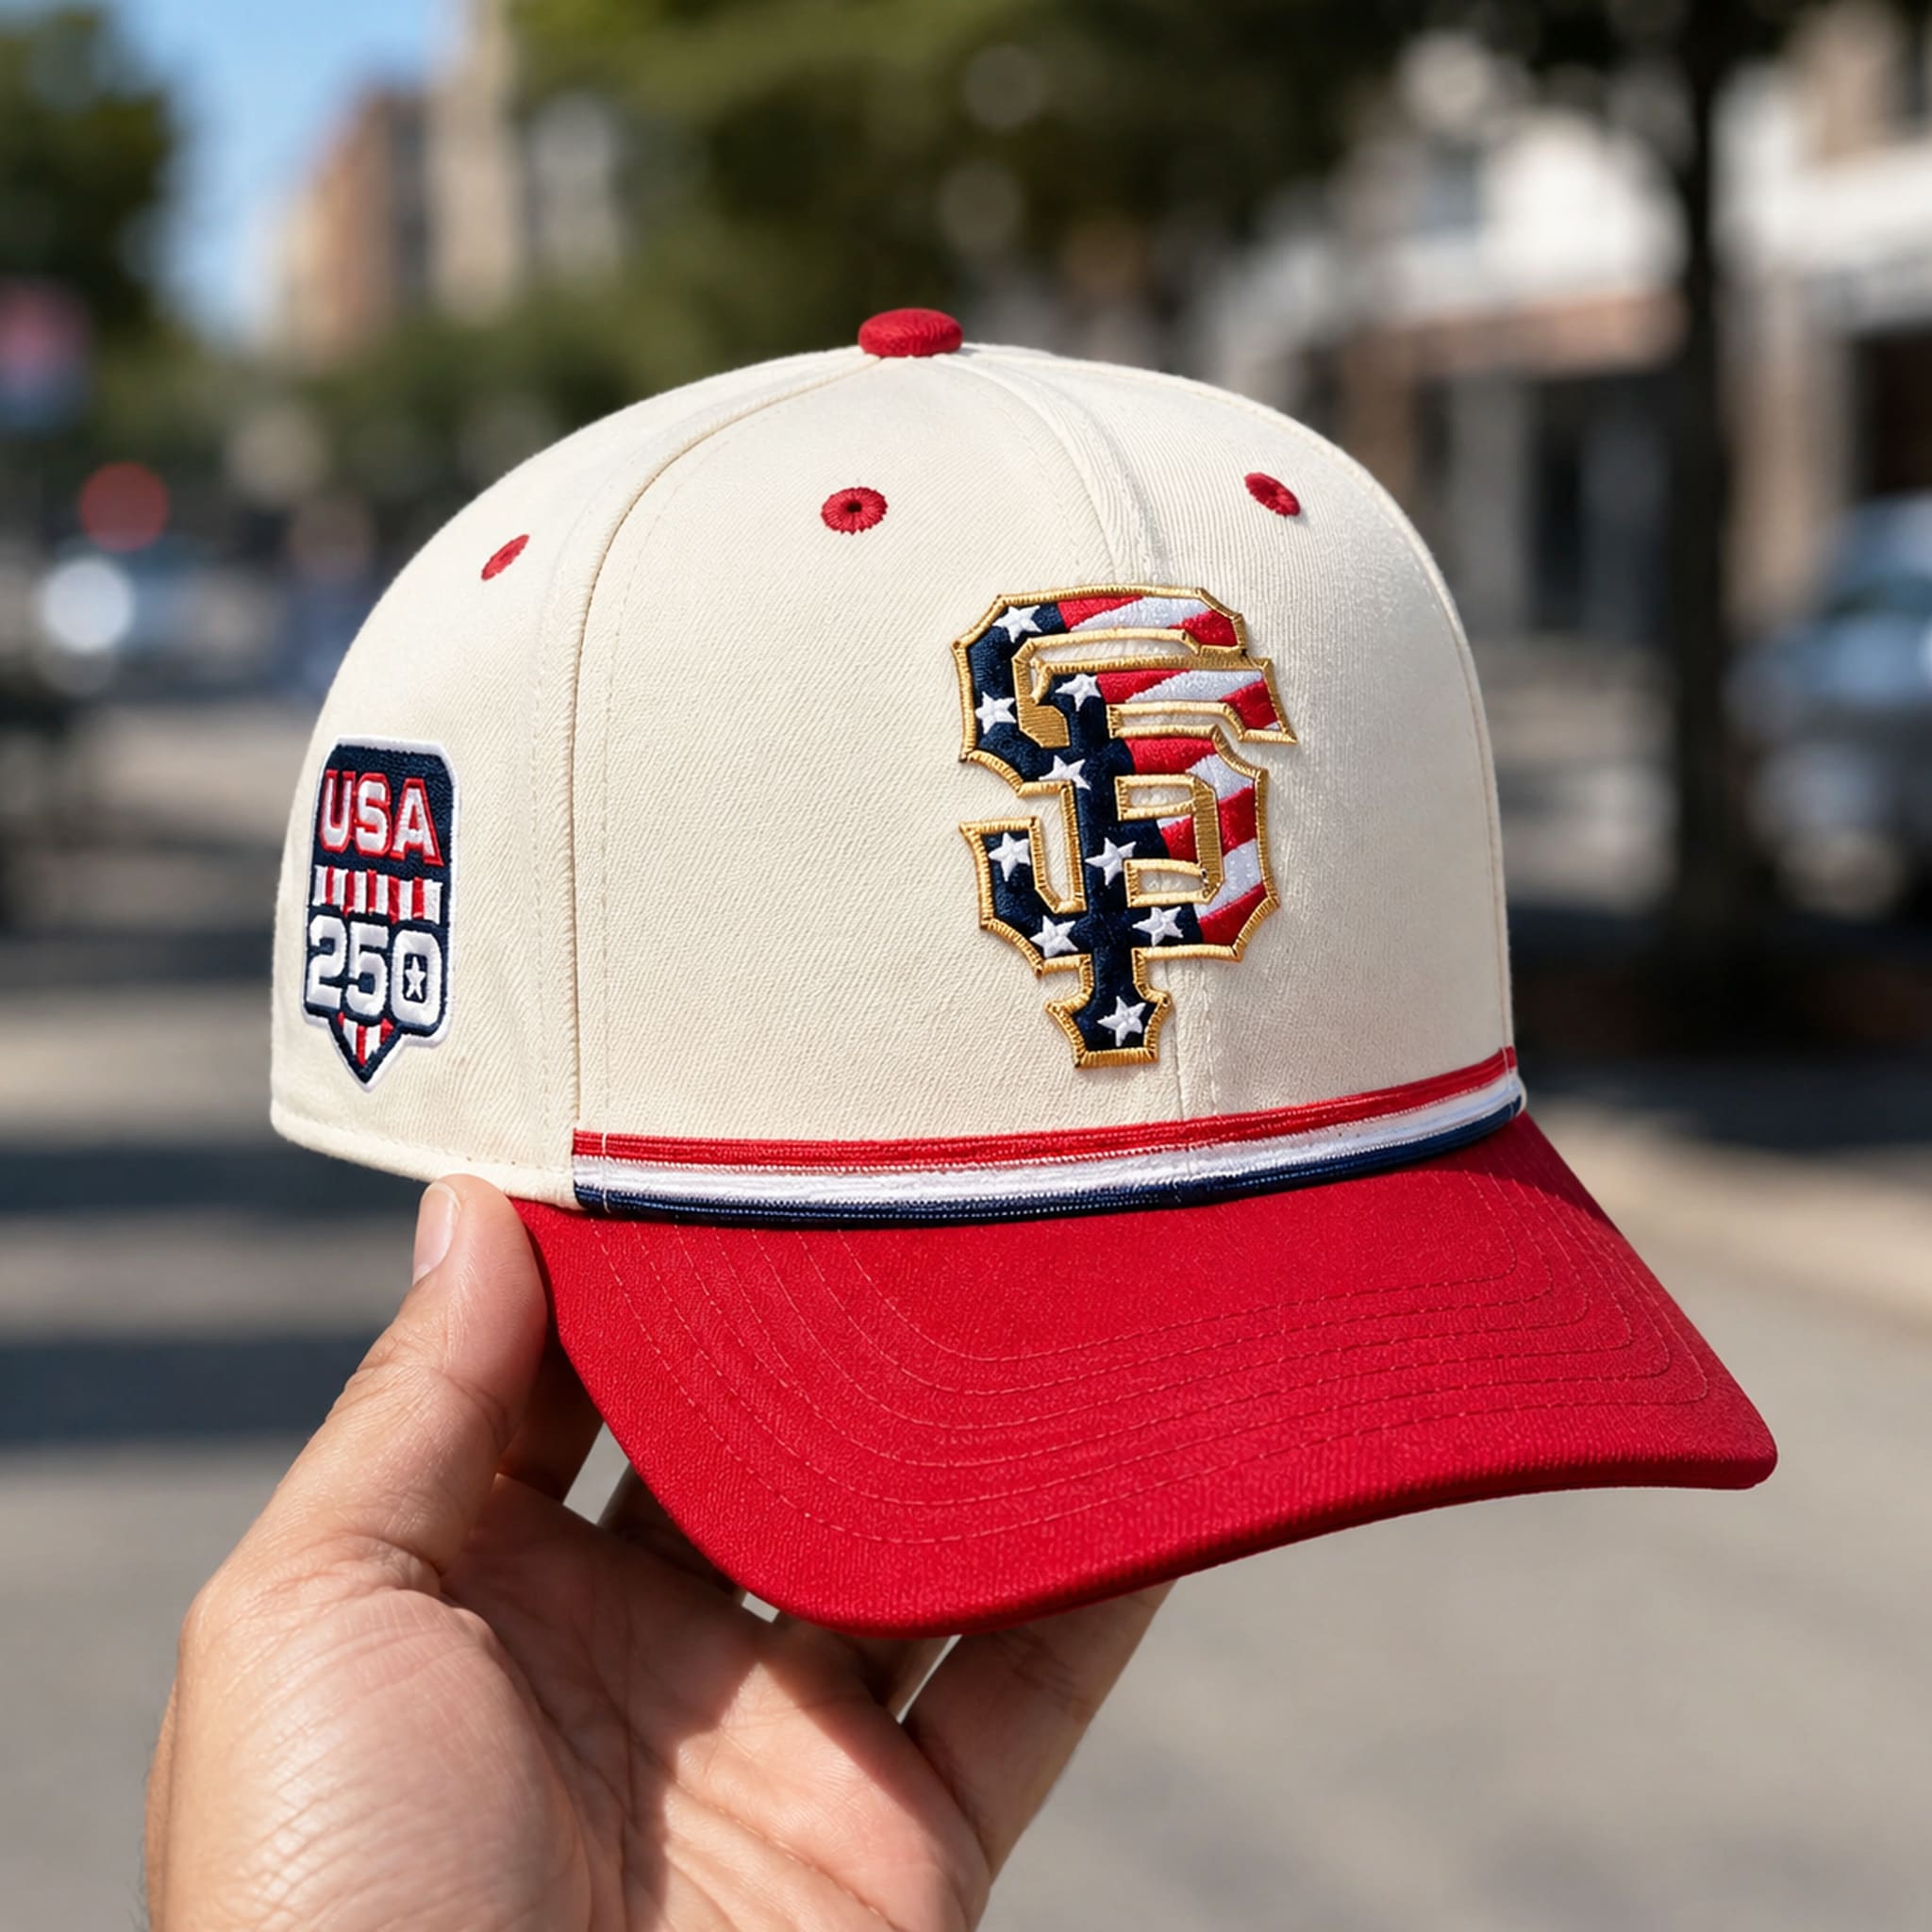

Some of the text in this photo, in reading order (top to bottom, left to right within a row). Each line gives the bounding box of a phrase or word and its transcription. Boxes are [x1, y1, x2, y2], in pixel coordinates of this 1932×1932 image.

[319, 769, 444, 866] USA
[951, 583, 1298, 1070] SF
[306, 914, 442, 1027] 250
